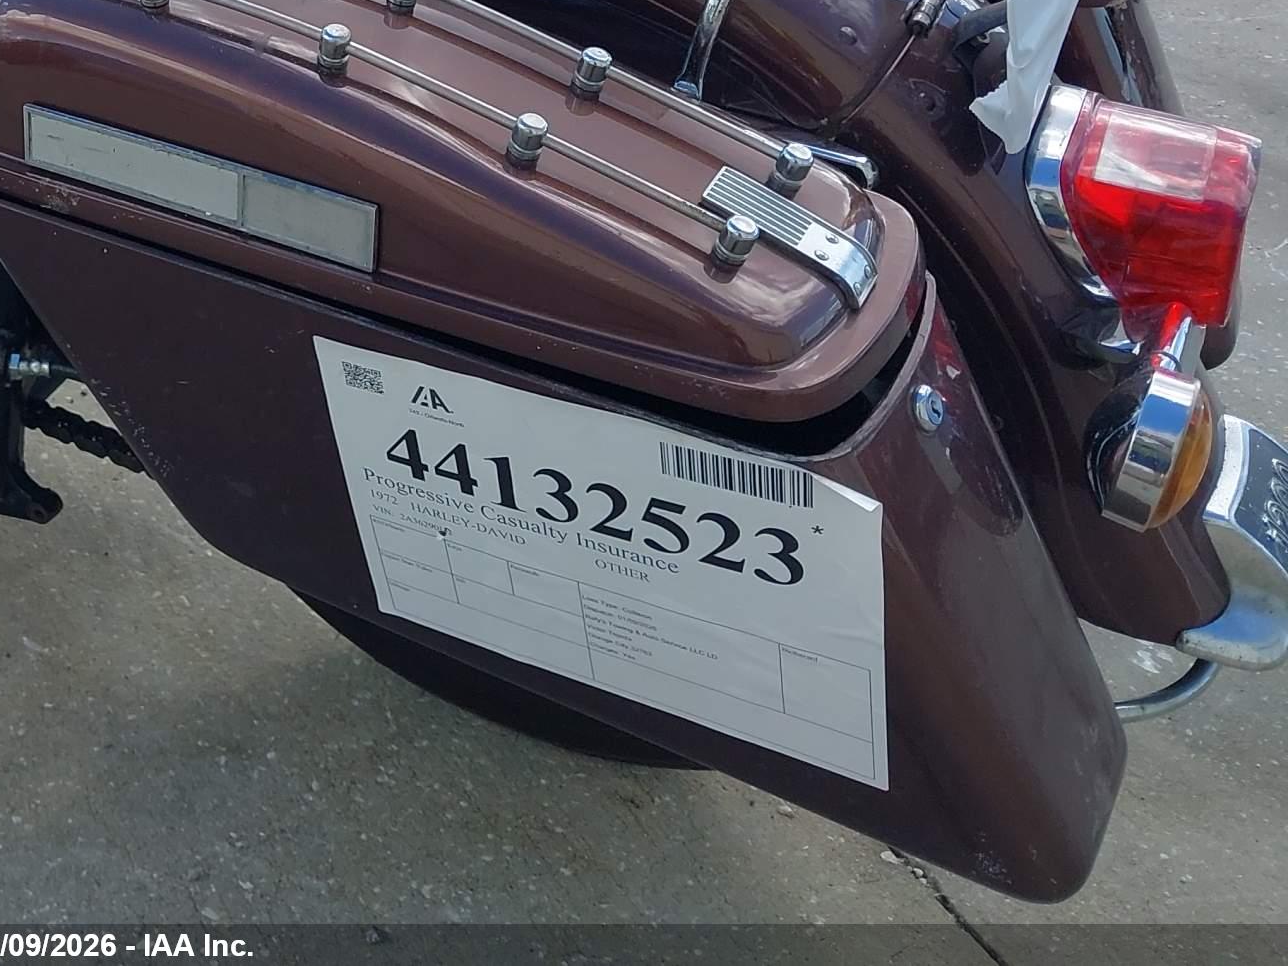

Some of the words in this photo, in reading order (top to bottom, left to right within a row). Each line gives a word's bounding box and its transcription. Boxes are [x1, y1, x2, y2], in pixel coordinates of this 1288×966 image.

[364, 467, 475, 514] Progressive
[480, 505, 568, 544] Casualty
[576, 532, 680, 575] Insurance
[370, 489, 399, 505] 1972
[410, 501, 527, 546] HARLEY-DAVID
[594, 558, 651, 583] OTHER
